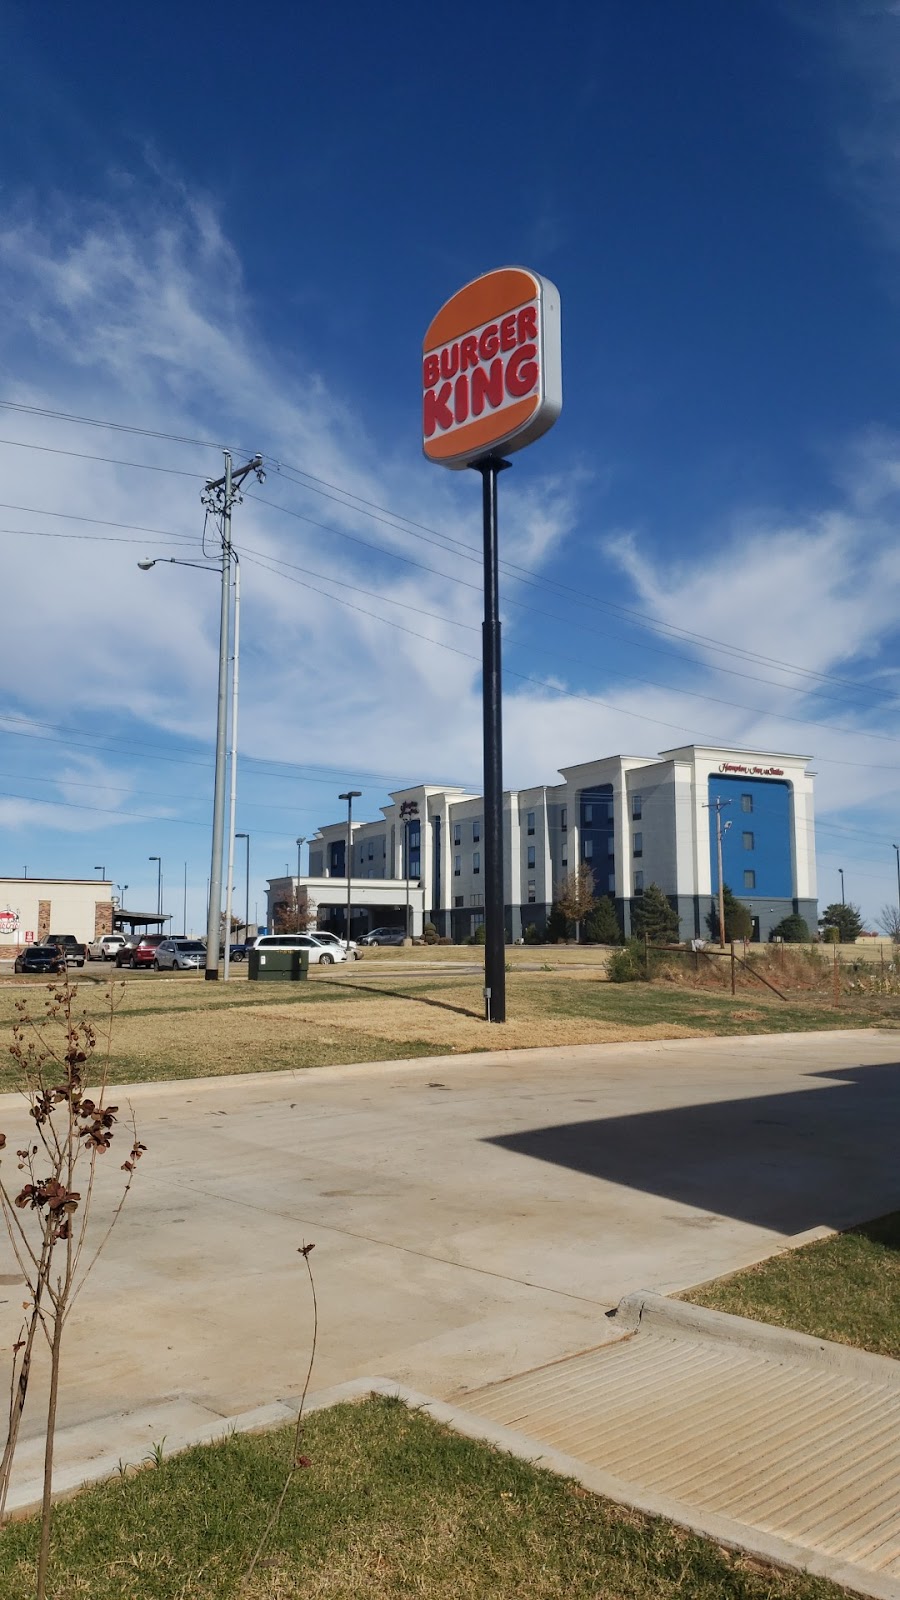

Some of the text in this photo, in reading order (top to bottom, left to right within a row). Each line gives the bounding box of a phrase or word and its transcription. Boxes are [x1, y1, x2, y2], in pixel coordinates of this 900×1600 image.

[423, 306, 538, 389] BURGER
[423, 343, 539, 437] KING
[719, 763, 748, 774] Hampton
